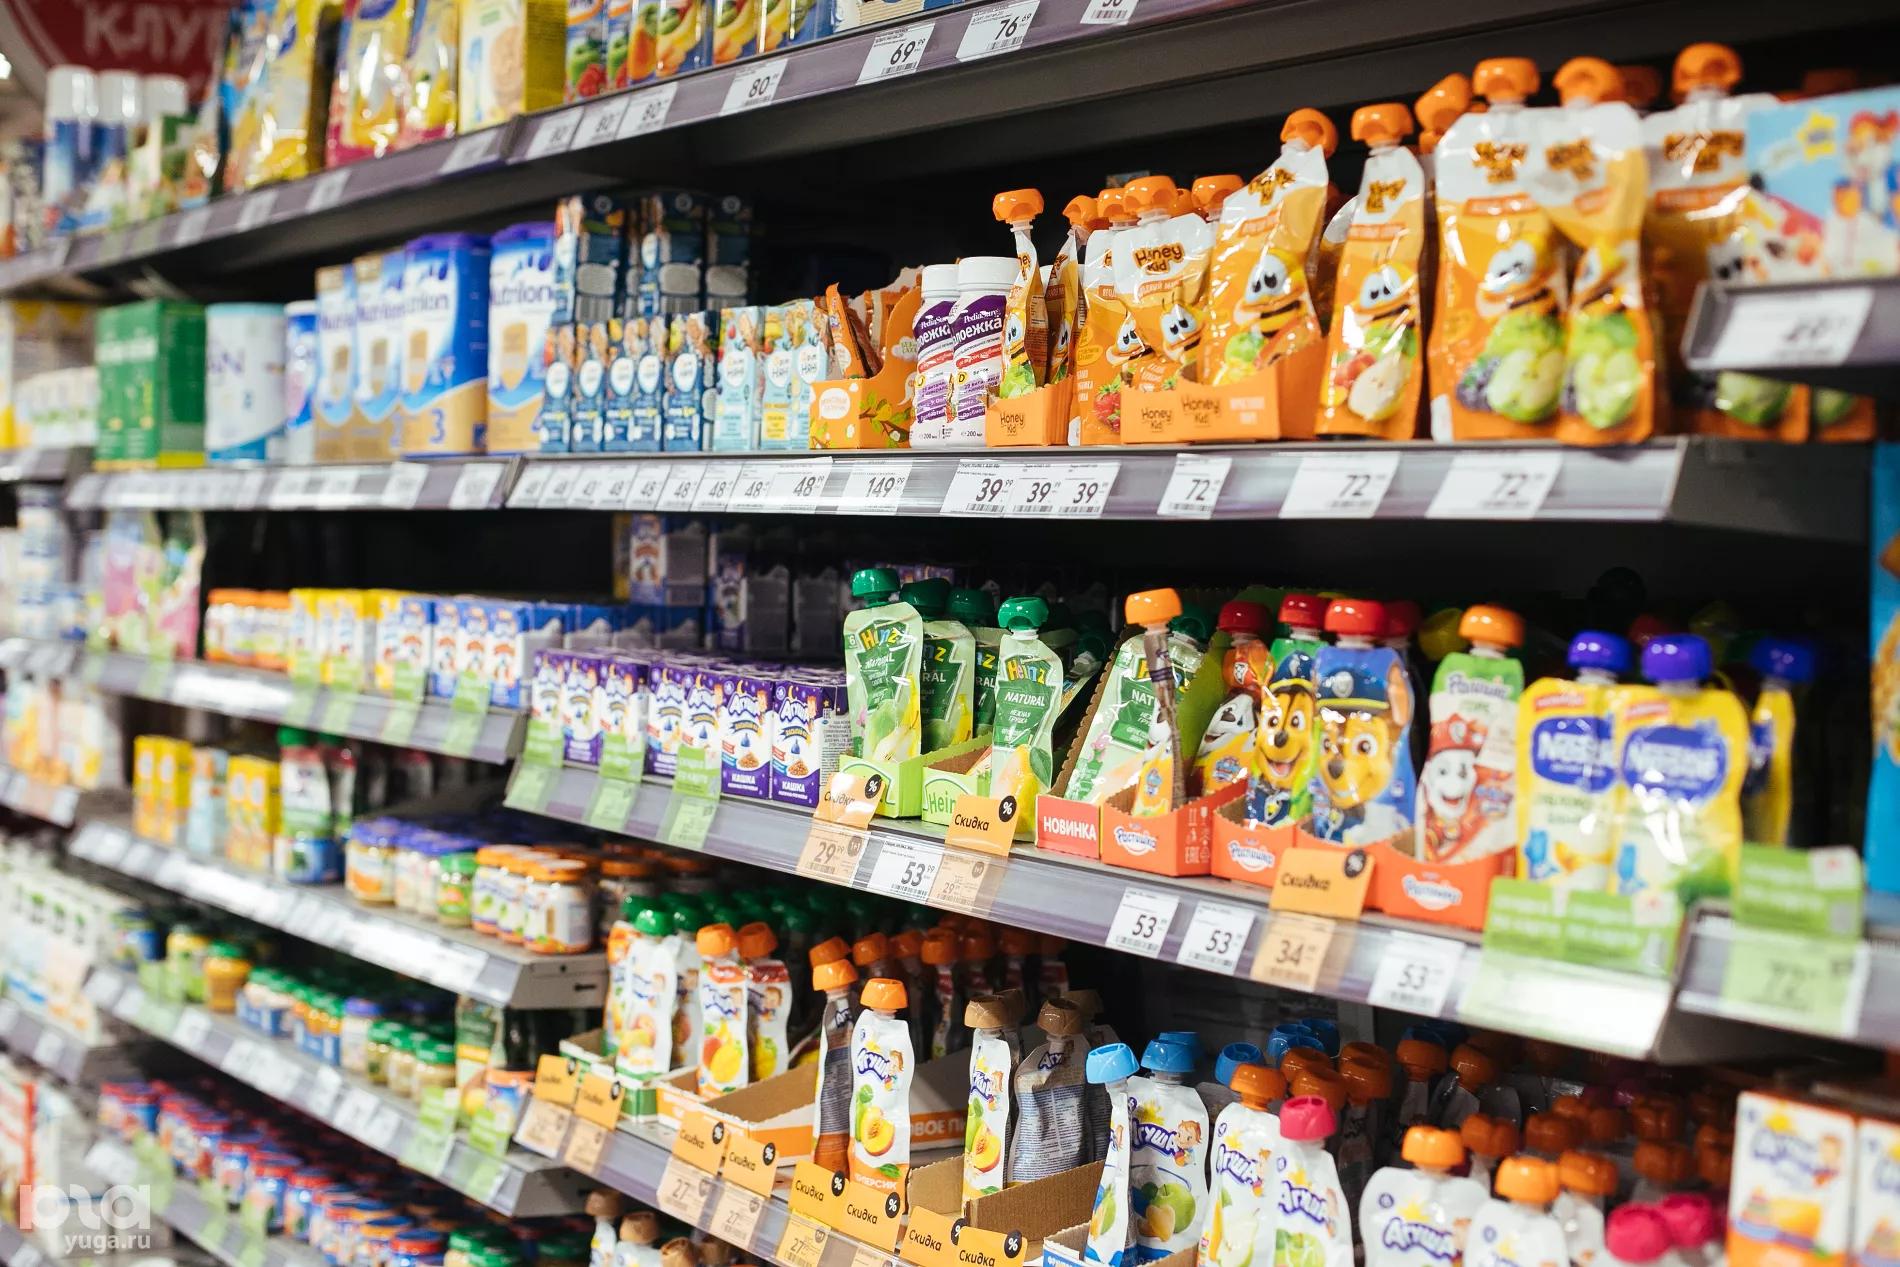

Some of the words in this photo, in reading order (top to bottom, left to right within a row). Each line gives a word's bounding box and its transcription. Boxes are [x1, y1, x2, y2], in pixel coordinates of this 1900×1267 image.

[995, 17, 1018, 41] 76
[890, 40, 917, 66] 69
[748, 75, 770, 98] 80
[1141, 408, 1172, 422] Honey
[1181, 396, 1220, 415] Honey
[429, 408, 445, 444] 3
[1000, 411, 1024, 430] Honey
[1006, 424, 1017, 434] Kid
[674, 481, 691, 498] 48
[709, 481, 727, 498] 48
[744, 481, 763, 498] 48
[793, 476, 817, 497] 48
[865, 476, 896, 498] 149
[976, 478, 1002, 501] 39
[1005, 479, 1013, 487] 99
[1027, 482, 1051, 503] 39
[1073, 482, 1098, 504] 39
[1186, 479, 1210, 501] 72
[1338, 474, 1370, 498] 72
[1493, 473, 1528, 498] 72
[849, 635, 857, 646] 6
[1007, 659, 1046, 685] Heinz
[1004, 691, 1046, 707] NATURAL
[782, 780, 805, 794] КАШКА
[1002, 801, 1013, 815] %
[954, 813, 990, 831] Скидка
[1043, 816, 1096, 841] НОВИНКА
[1116, 827, 1157, 849] Растишка
[814, 841, 836, 864] 29
[901, 861, 926, 886] 53
[927, 865, 935, 873] 99
[1281, 872, 1331, 891] Скидка
[1132, 914, 1157, 938] 53
[1206, 929, 1233, 954] 53
[1276, 939, 1305, 966] 34
[1398, 963, 1429, 989] 53
[680, 1128, 705, 1150] Скидка
[728, 1150, 756, 1172] Скидка
[672, 1179, 690, 1199] 27
[795, 1179, 824, 1202] Скидка
[834, 1176, 843, 1190] %
[855, 1173, 898, 1189] ПЕРСИК
[846, 1203, 878, 1225] Скидка
[889, 1198, 898, 1212] %
[726, 1210, 738, 1224] 27
[790, 1238, 804, 1254] 27
[908, 1229, 942, 1252] Скидка
[1008, 1237, 1018, 1251] %
[959, 1249, 996, 1267] Скидка
